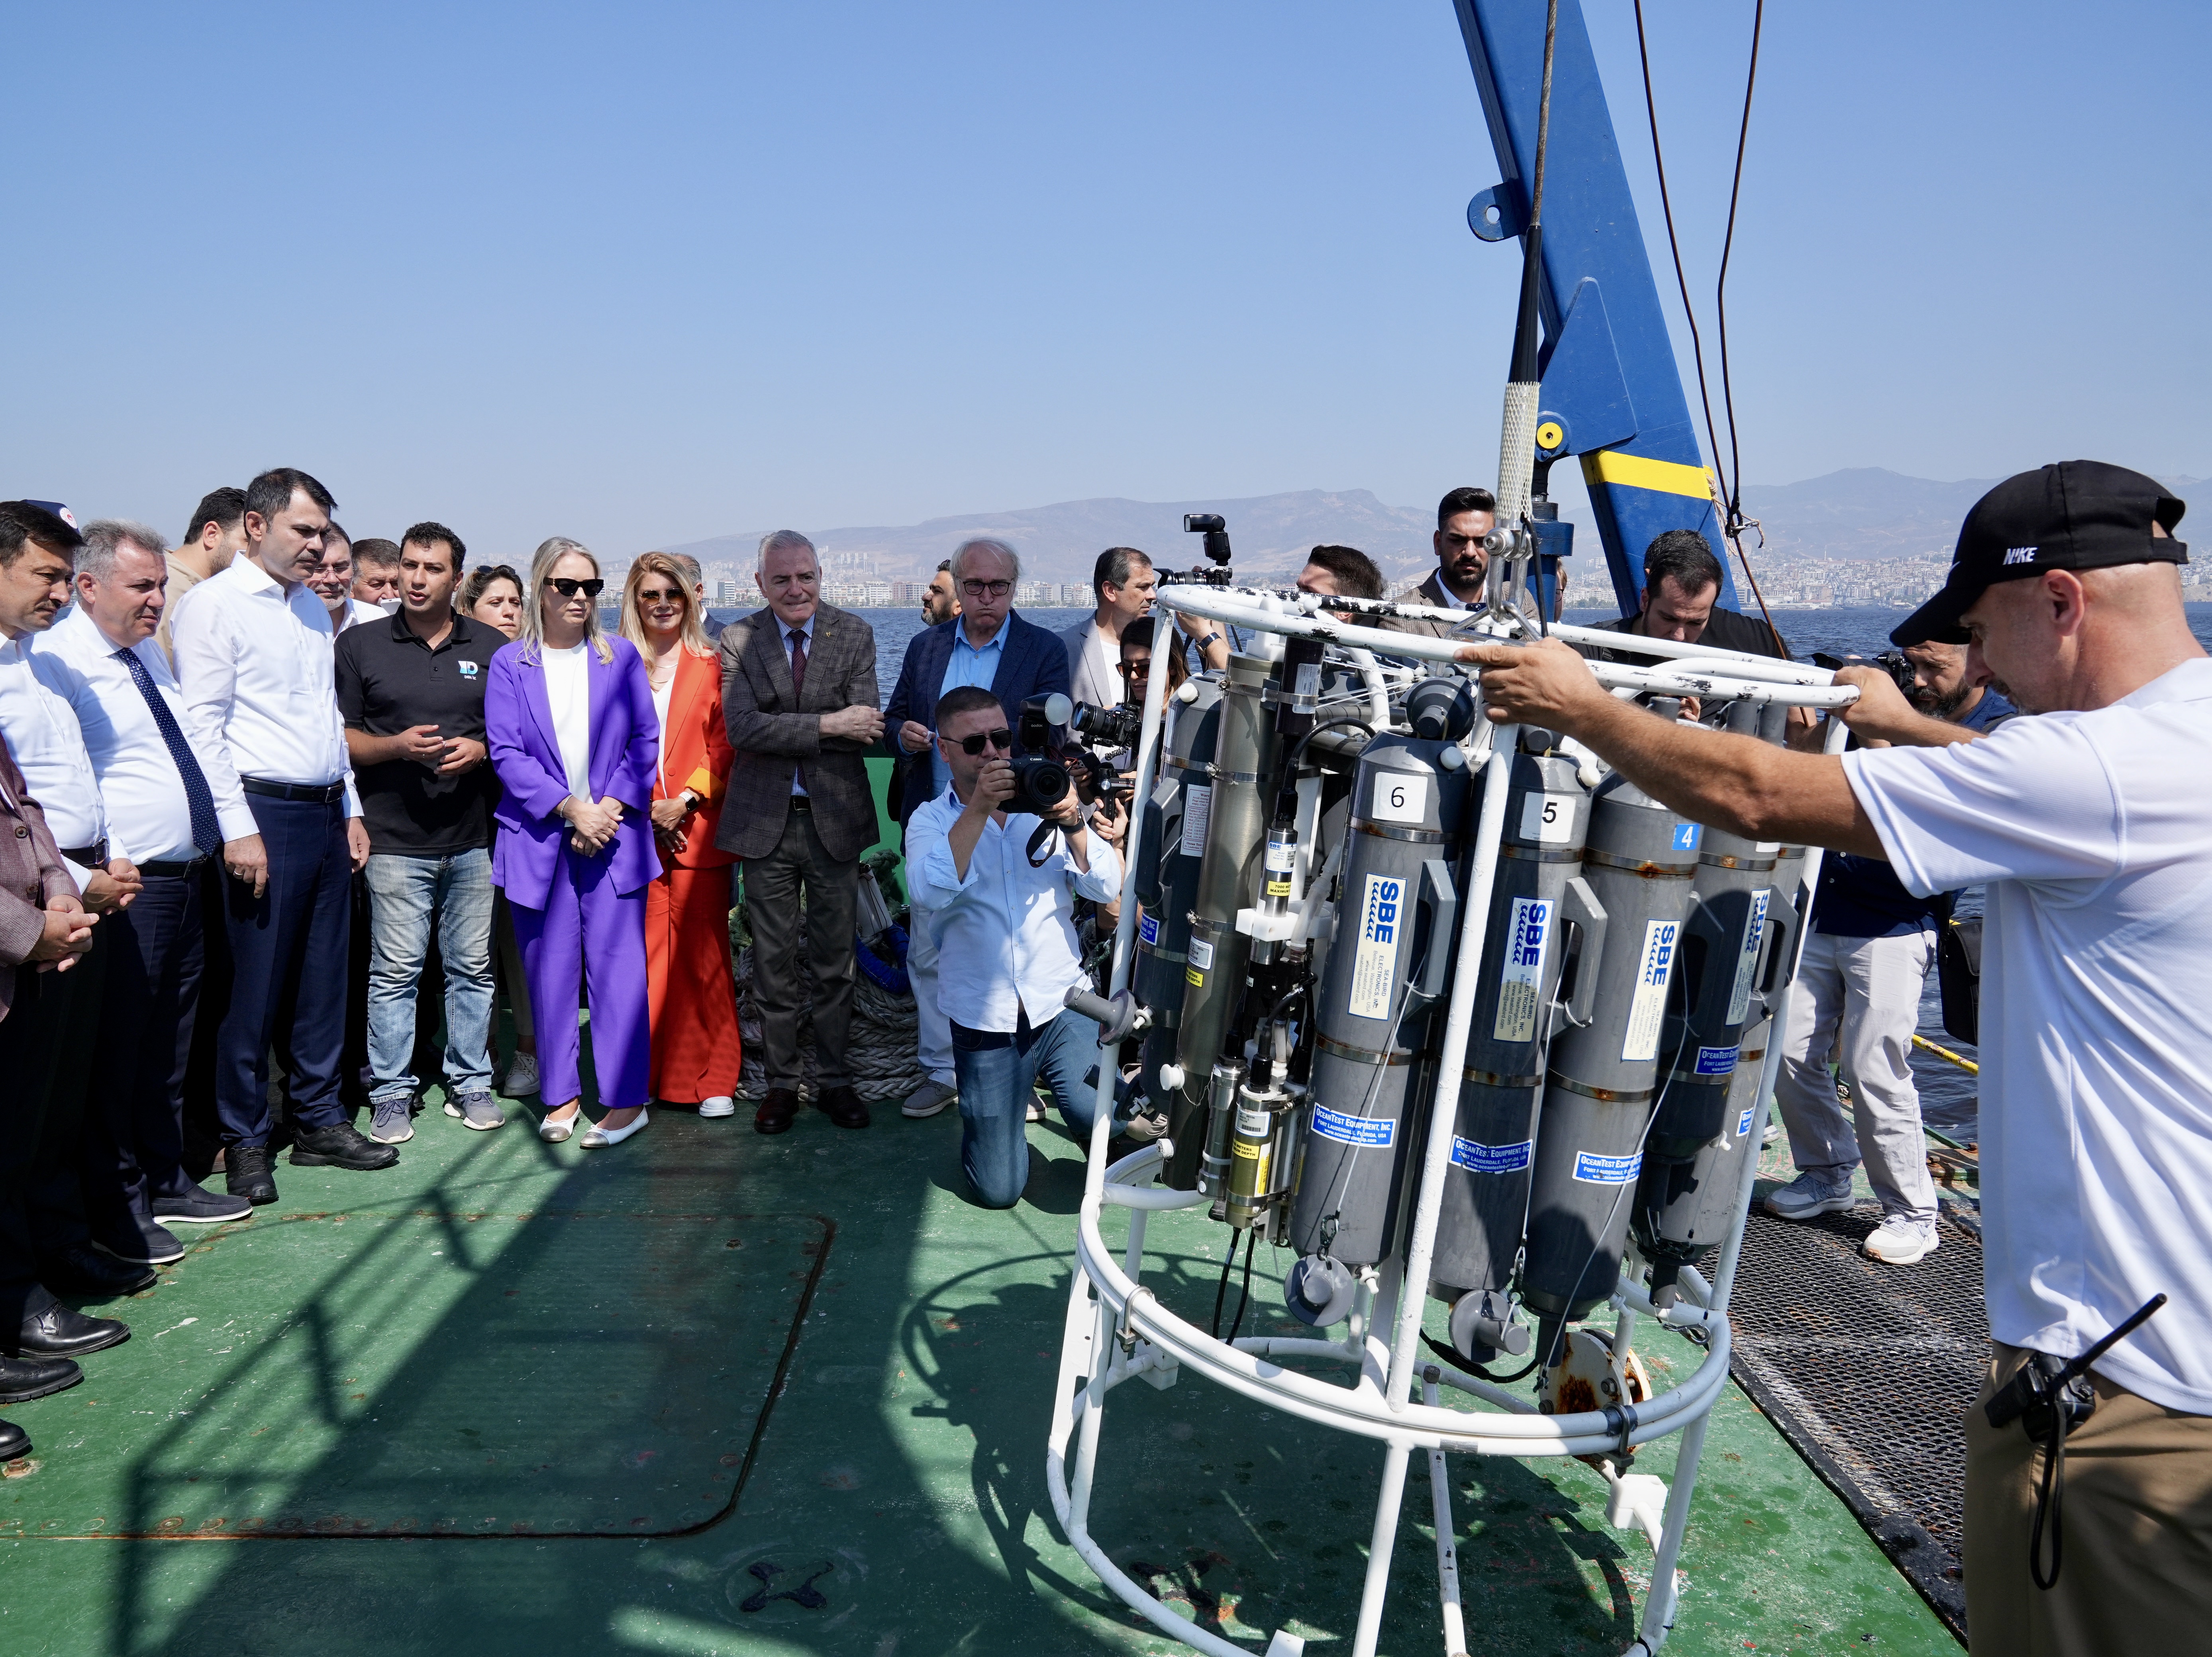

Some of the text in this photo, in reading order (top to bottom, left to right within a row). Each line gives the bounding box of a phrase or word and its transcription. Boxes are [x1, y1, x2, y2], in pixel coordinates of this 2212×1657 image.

[2002, 546, 2037, 565] NIKE
[1391, 787, 1404, 807] 6
[1542, 802, 1557, 823] 5
[1681, 826, 1693, 848] 4
[1374, 881, 1399, 944] SBE
[1751, 893, 1768, 953] SBE
[1521, 903, 1546, 966] SBE
[1374, 955, 1384, 997] ELECTRONICS,
[1652, 925, 1675, 986] SBE
[1355, 954, 1364, 1003] seabird@seabird.com
[1367, 972, 1375, 1001] Washington,
[1381, 969, 1390, 997] SEA-BIRD
[1520, 978, 1531, 1020] ELECTRONICS,
[1500, 979, 1511, 1029] seabird@seabird.com
[1507, 985, 1516, 1025] www.seabird.com
[1513, 997, 1522, 1024] Washington,
[1527, 991, 1535, 1019] SEA-BIRD
[1629, 1000, 1641, 1049] seabird@seabird.com
